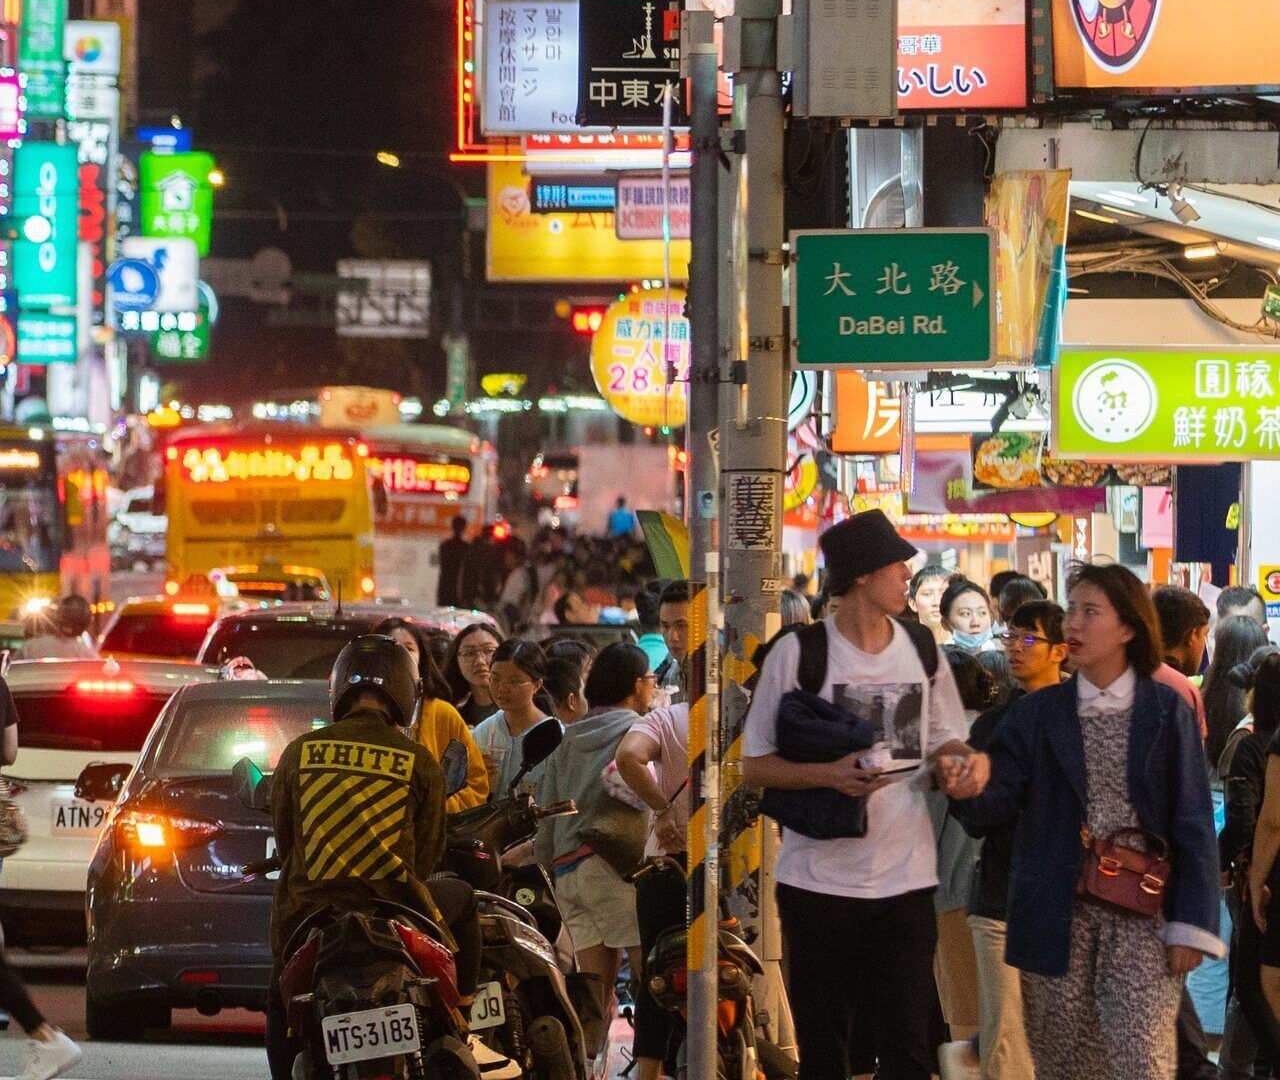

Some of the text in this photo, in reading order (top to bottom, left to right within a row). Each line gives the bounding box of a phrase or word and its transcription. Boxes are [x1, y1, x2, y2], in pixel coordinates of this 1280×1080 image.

[898, 34, 943, 55] 哥華
[823, 260, 968, 299] 大北路
[839, 316, 947, 336] DaBei Rd.
[1194, 359, 1280, 399] 圓稼
[1172, 405, 1280, 450] 鮮奶茶
[306, 742, 411, 778] WHITE
